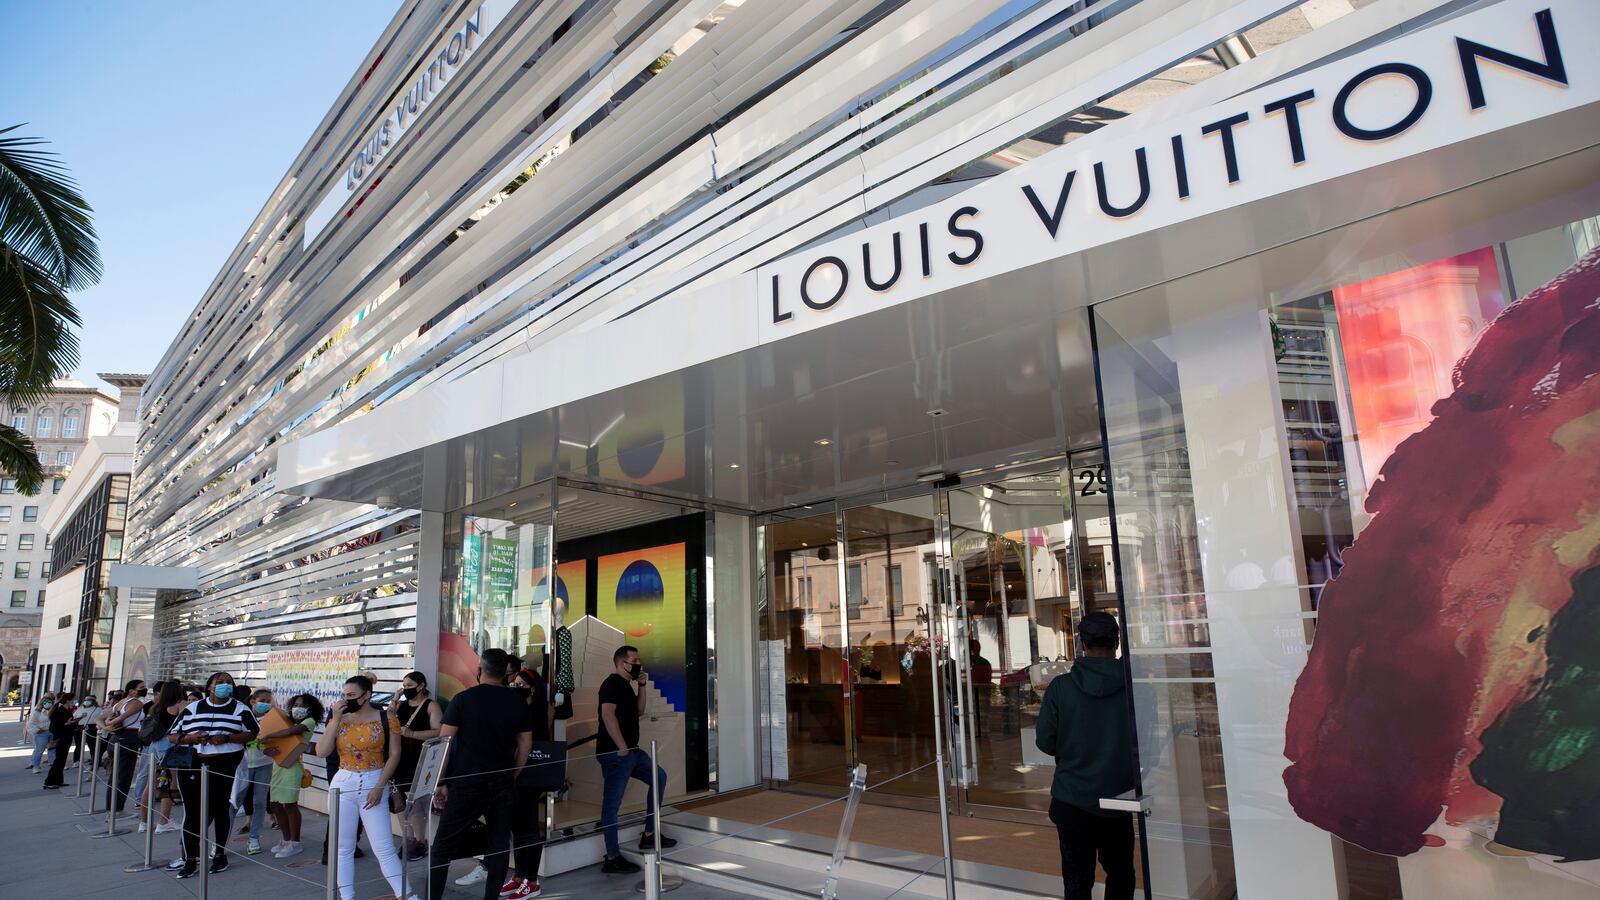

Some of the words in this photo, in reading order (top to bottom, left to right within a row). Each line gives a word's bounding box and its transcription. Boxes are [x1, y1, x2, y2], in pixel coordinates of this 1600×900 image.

[346, 118, 393, 190] LOUIS
[396, 5, 483, 129] VUITTON
[771, 206, 985, 324] LOUIS
[1021, 8, 1569, 240] VUITTON
